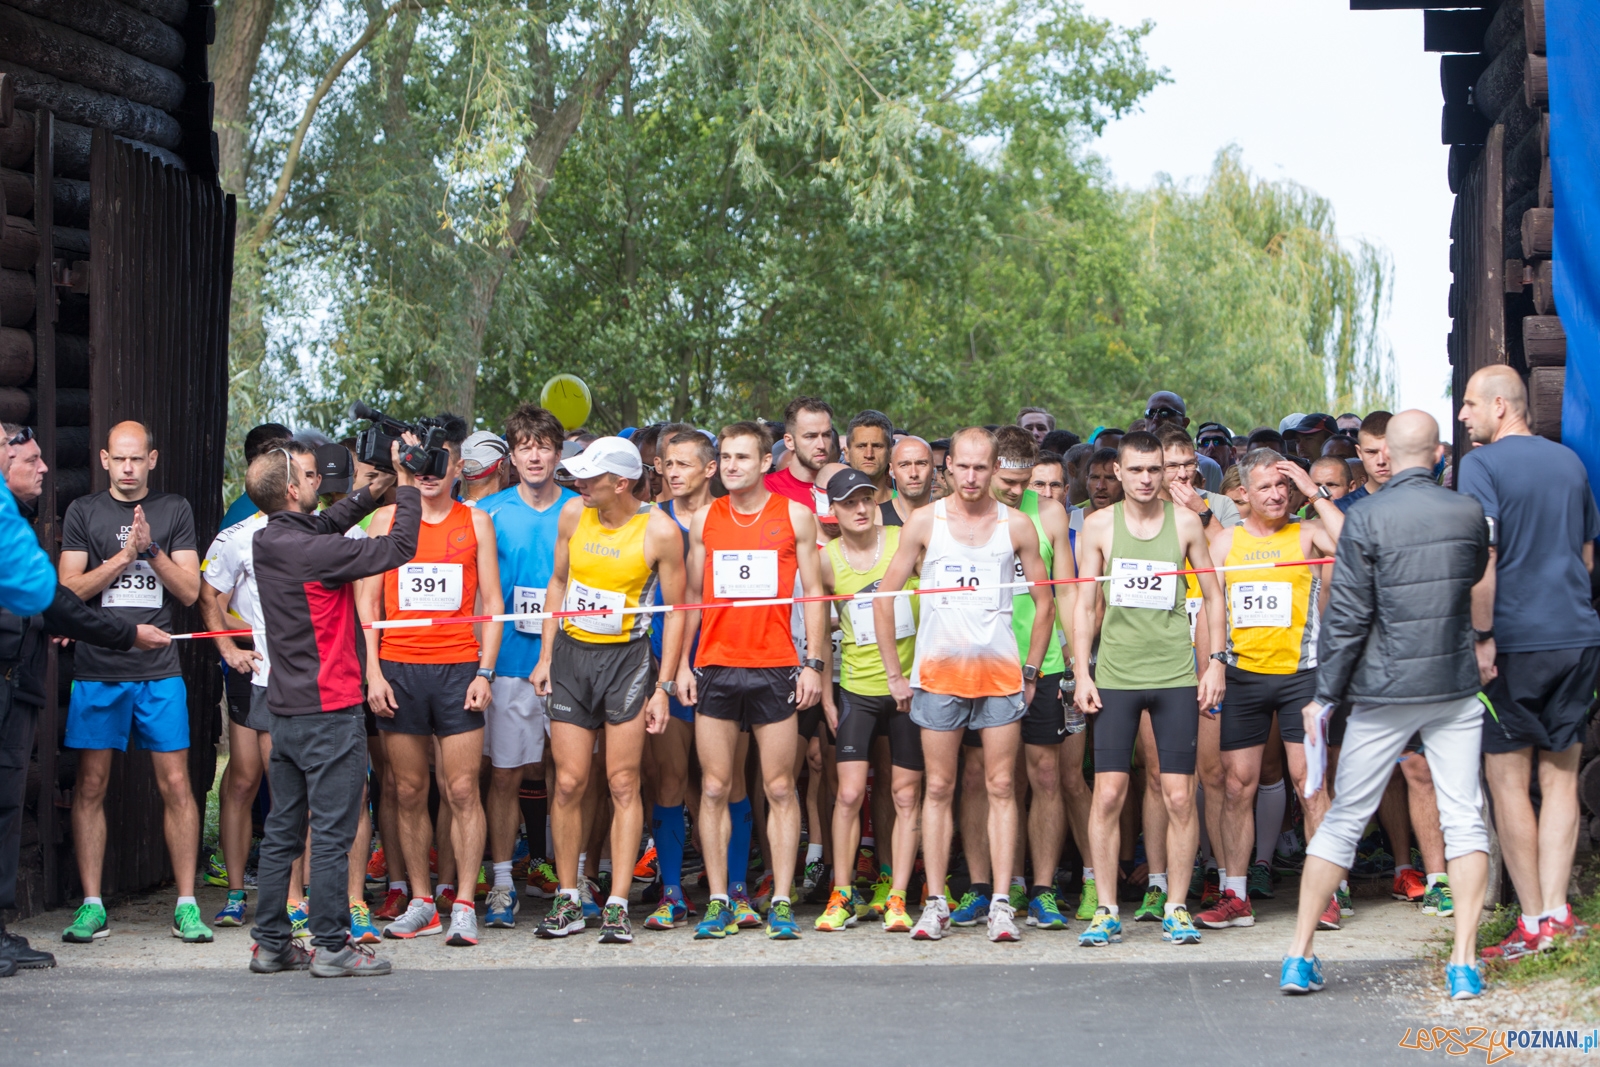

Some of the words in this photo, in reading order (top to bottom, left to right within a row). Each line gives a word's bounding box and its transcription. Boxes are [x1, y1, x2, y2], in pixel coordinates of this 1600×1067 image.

[739, 564, 751, 580] 8
[108, 574, 157, 590] 2538
[411, 577, 446, 593] 391
[956, 576, 980, 591] 10
[1124, 575, 1162, 591] 392
[577, 598, 608, 619] 511
[1243, 595, 1278, 610] 518
